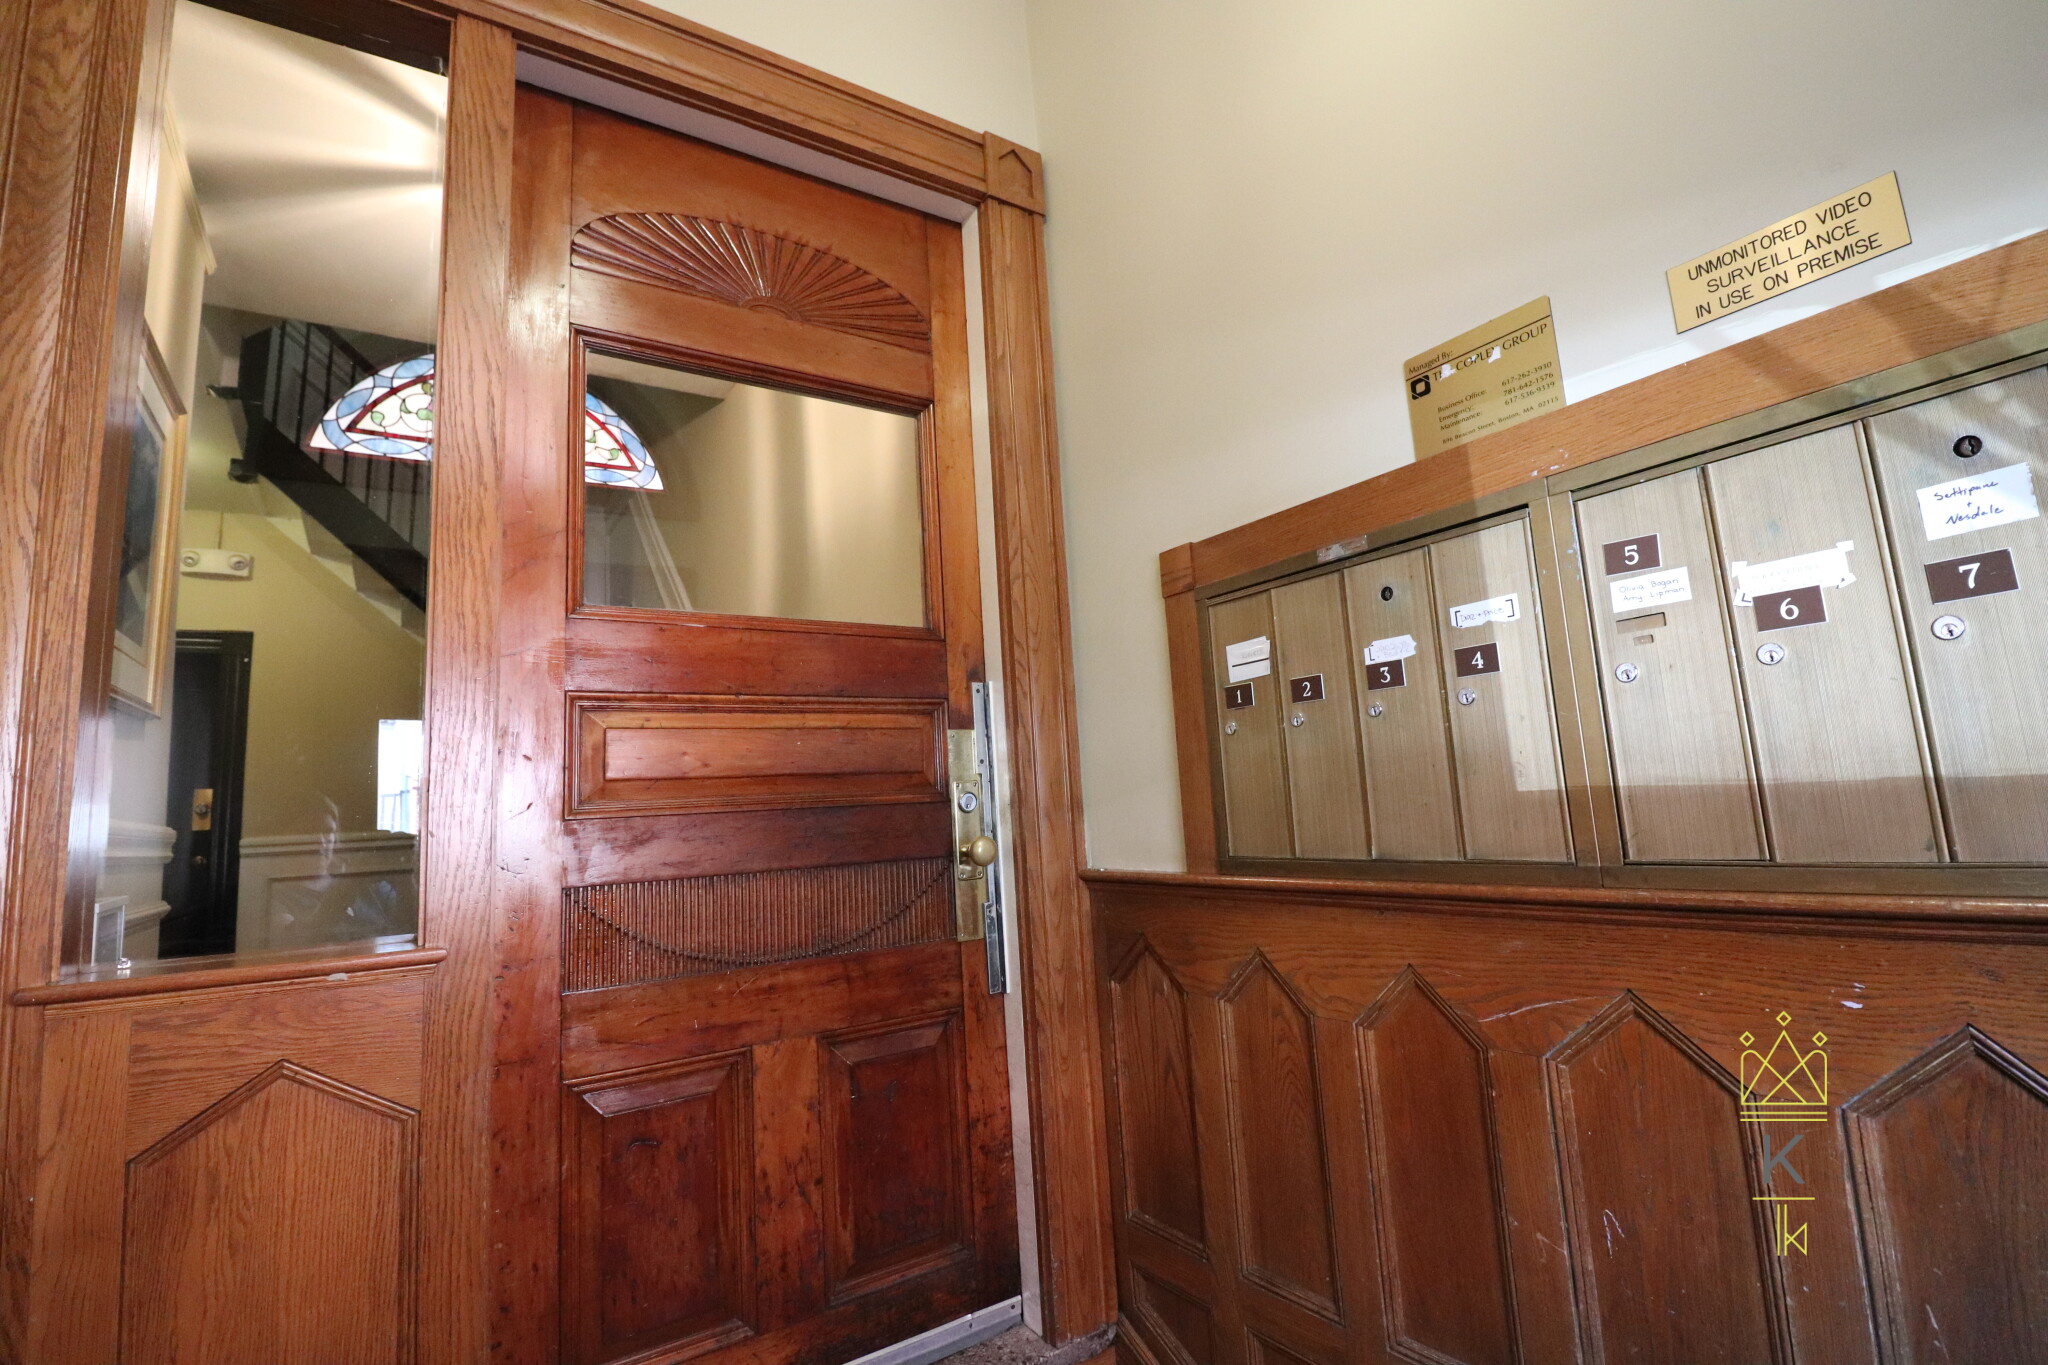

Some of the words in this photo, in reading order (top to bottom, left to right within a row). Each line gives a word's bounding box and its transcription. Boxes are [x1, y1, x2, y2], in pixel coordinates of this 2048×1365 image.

[1687, 220, 1807, 281] UNMONITORED
[1815, 191, 1872, 225] VIDEO
[1706, 218, 1860, 293] SURVEILLANCE
[1695, 304, 1712, 319] IN
[1719, 284, 1754, 309] USE
[1763, 270, 1789, 291] ON
[1797, 232, 1883, 279] PREMISE
[1456, 346, 1497, 371] COPLE
[1502, 323, 1547, 350] GROUP
[1408, 355, 1440, 375] Managed
[1441, 350, 1453, 361] By:
[1503, 372, 1554, 397] 781-642-1576
[1437, 399, 1464, 413] Business
[1624, 544, 1639, 565] 5
[1958, 562, 1981, 589] 7
[1618, 584, 1645, 593] Olivia
[1623, 594, 1643, 603] Amy
[1649, 587, 1685, 599] Lipman
[1780, 597, 1799, 620] 6
[1471, 651, 1484, 669] 4
[1379, 666, 1391, 683] 3
[1236, 689, 1242, 704] 1
[1302, 681, 1312, 697] 2
